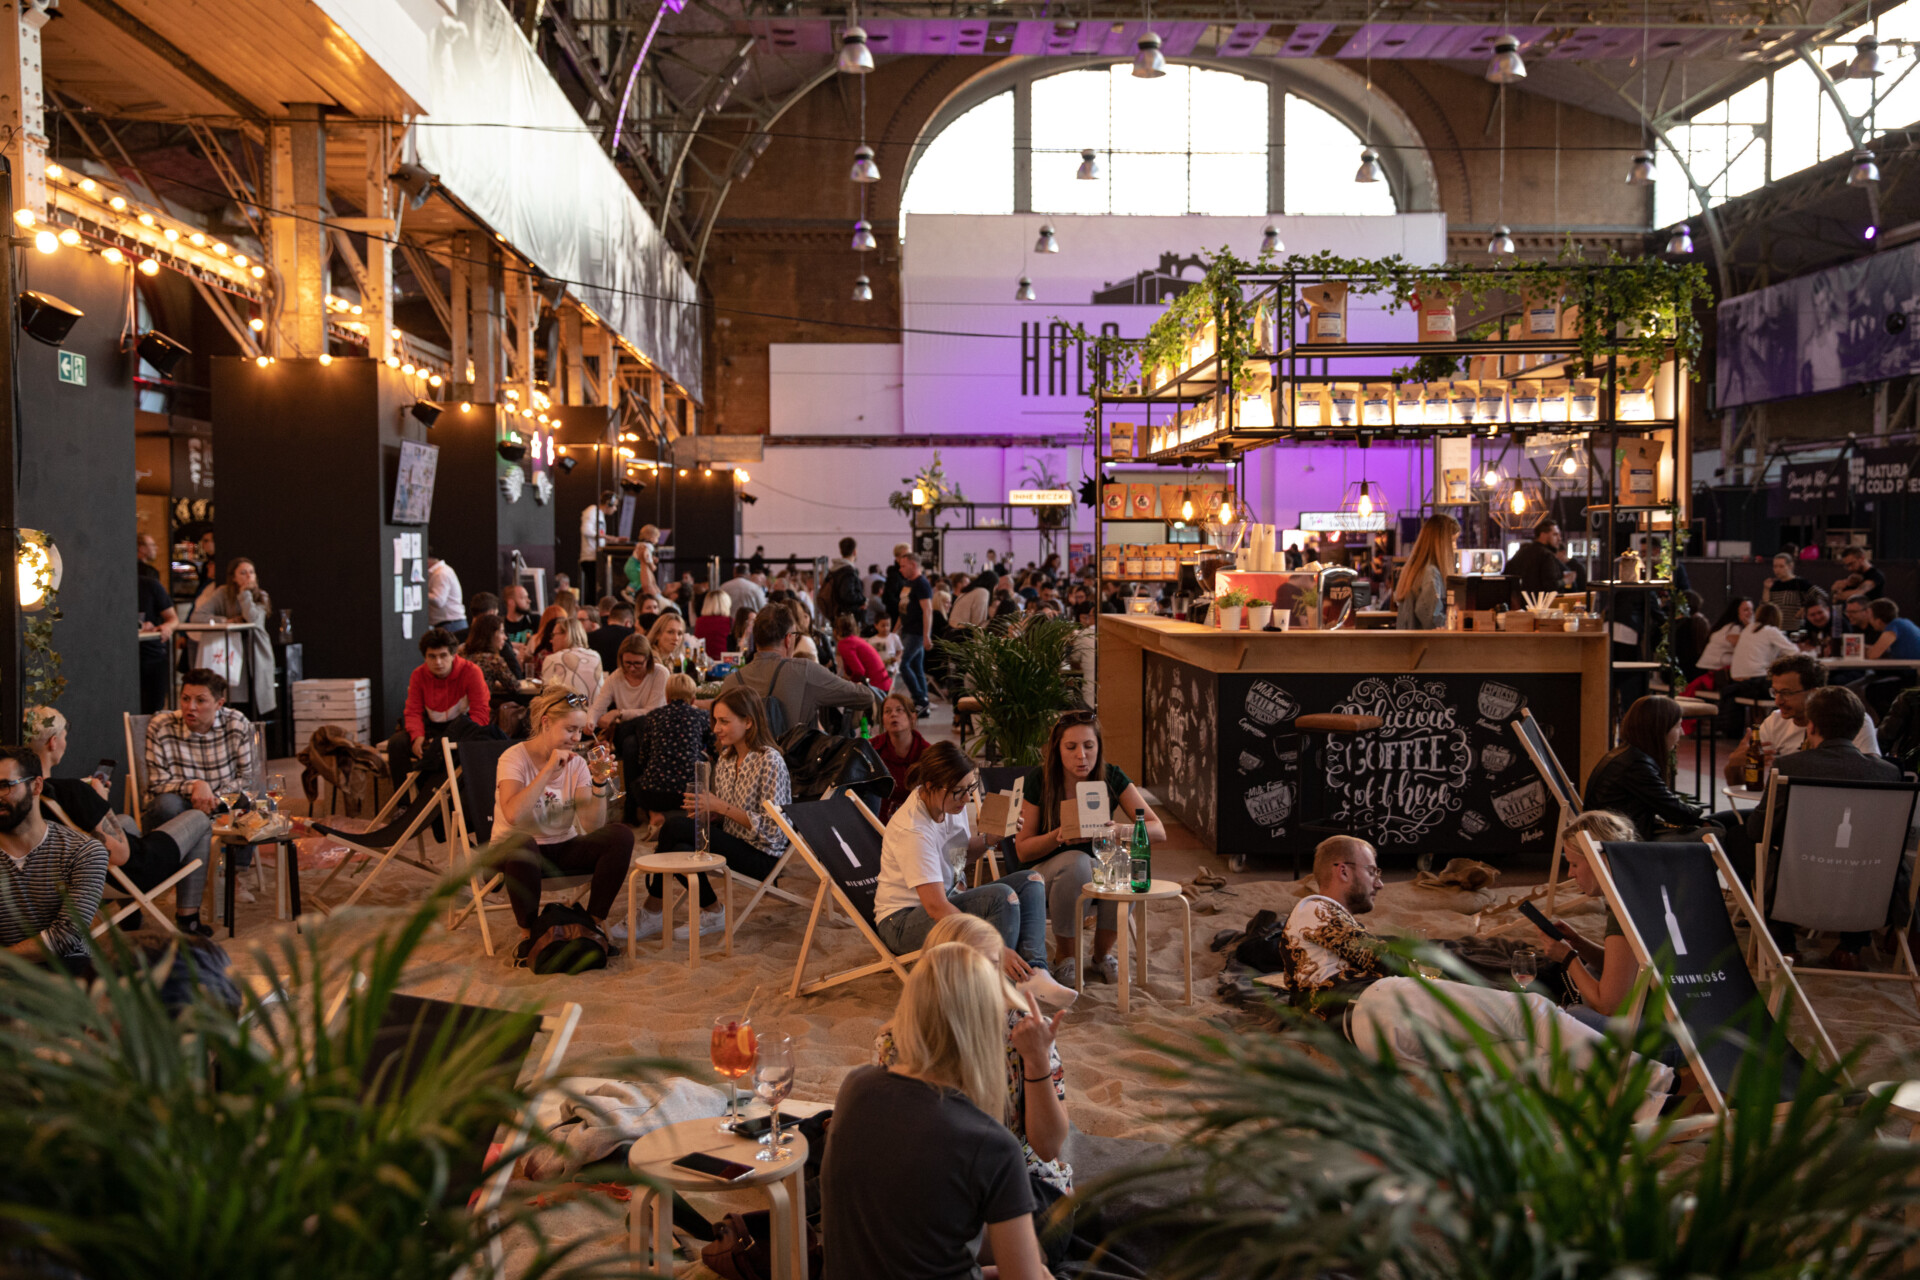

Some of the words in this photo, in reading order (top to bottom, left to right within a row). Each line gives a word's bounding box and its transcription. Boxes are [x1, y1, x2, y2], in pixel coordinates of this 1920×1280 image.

[1021, 321, 1119, 396] HALA
[1866, 479, 1895, 494] COLD
[1250, 693, 1283, 719] MILK
[1394, 770, 1451, 815] here
[1254, 799, 1287, 816] MILK
[1502, 796, 1541, 816] MILK
